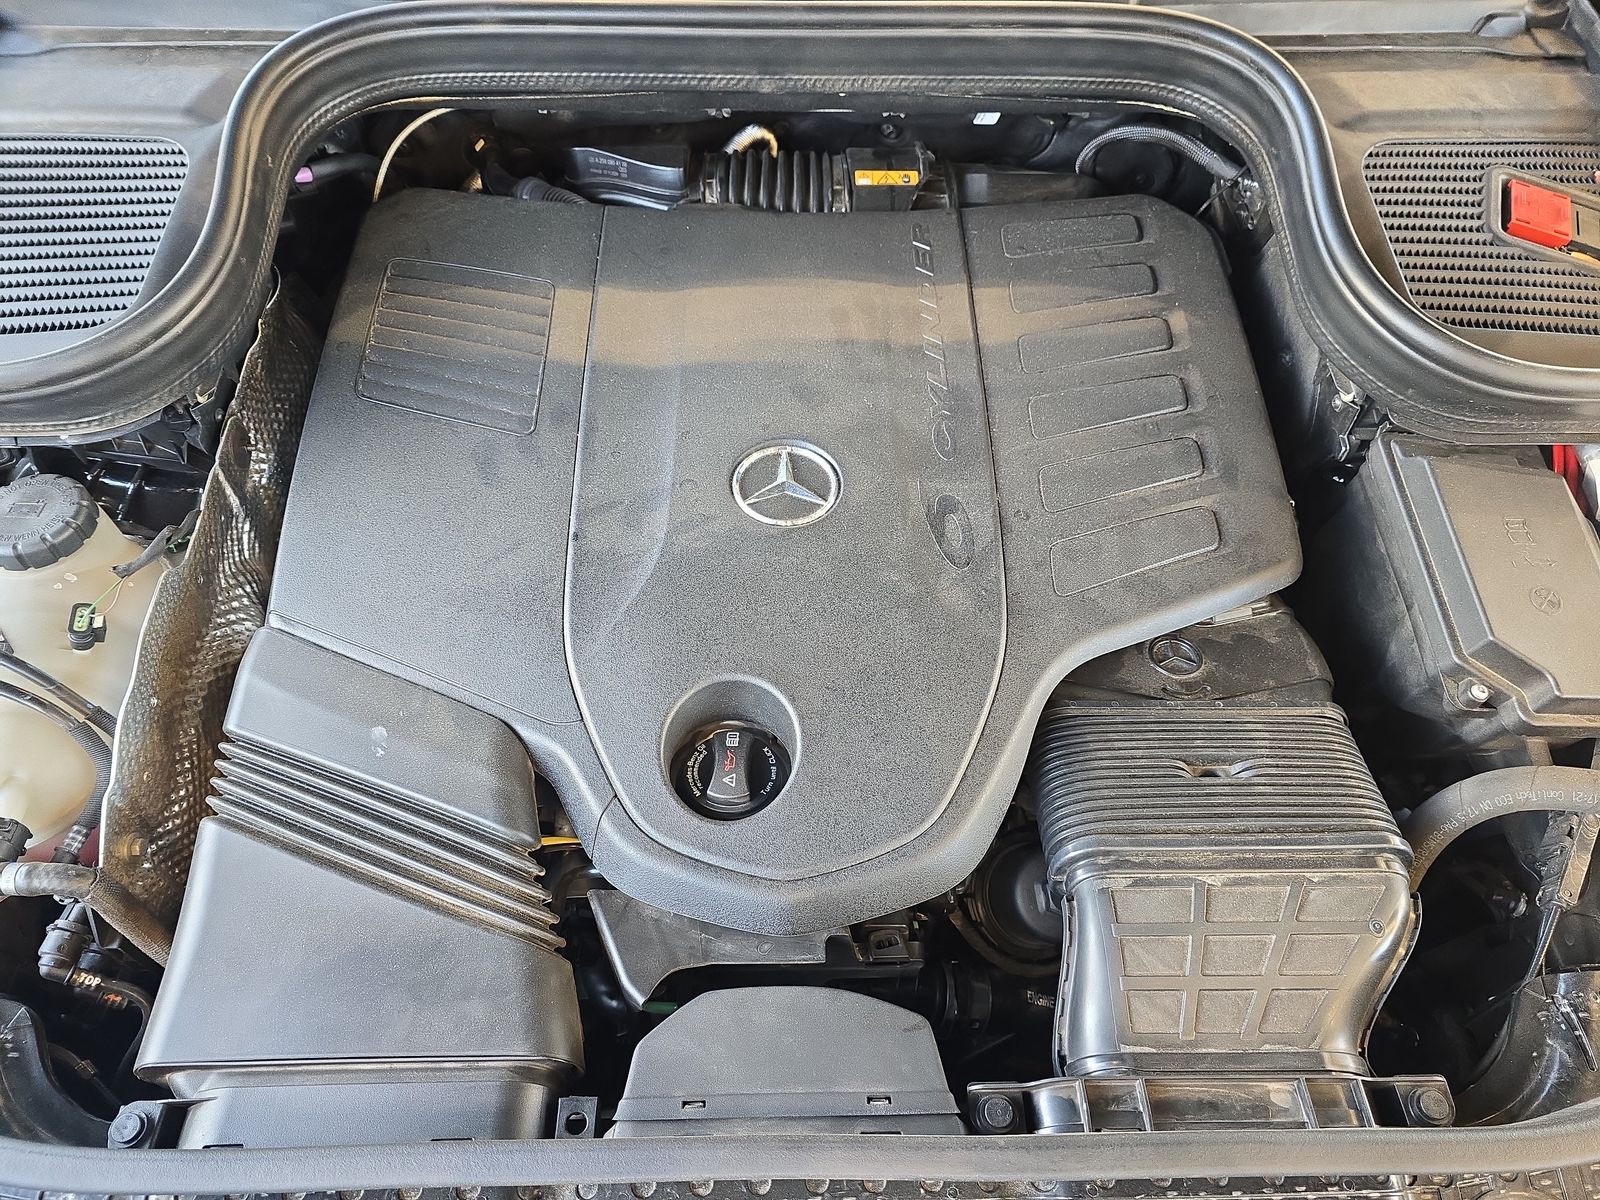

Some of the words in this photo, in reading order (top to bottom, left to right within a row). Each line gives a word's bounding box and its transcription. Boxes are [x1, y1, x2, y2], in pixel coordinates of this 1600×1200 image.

[911, 222, 954, 462] CYLINDER
[762, 746, 776, 764] CLICK
[693, 749, 708, 790] recommended
[759, 782, 774, 795] Turn
[1495, 793, 1513, 807] ECO
[1026, 990, 1056, 1008] ENGINE
